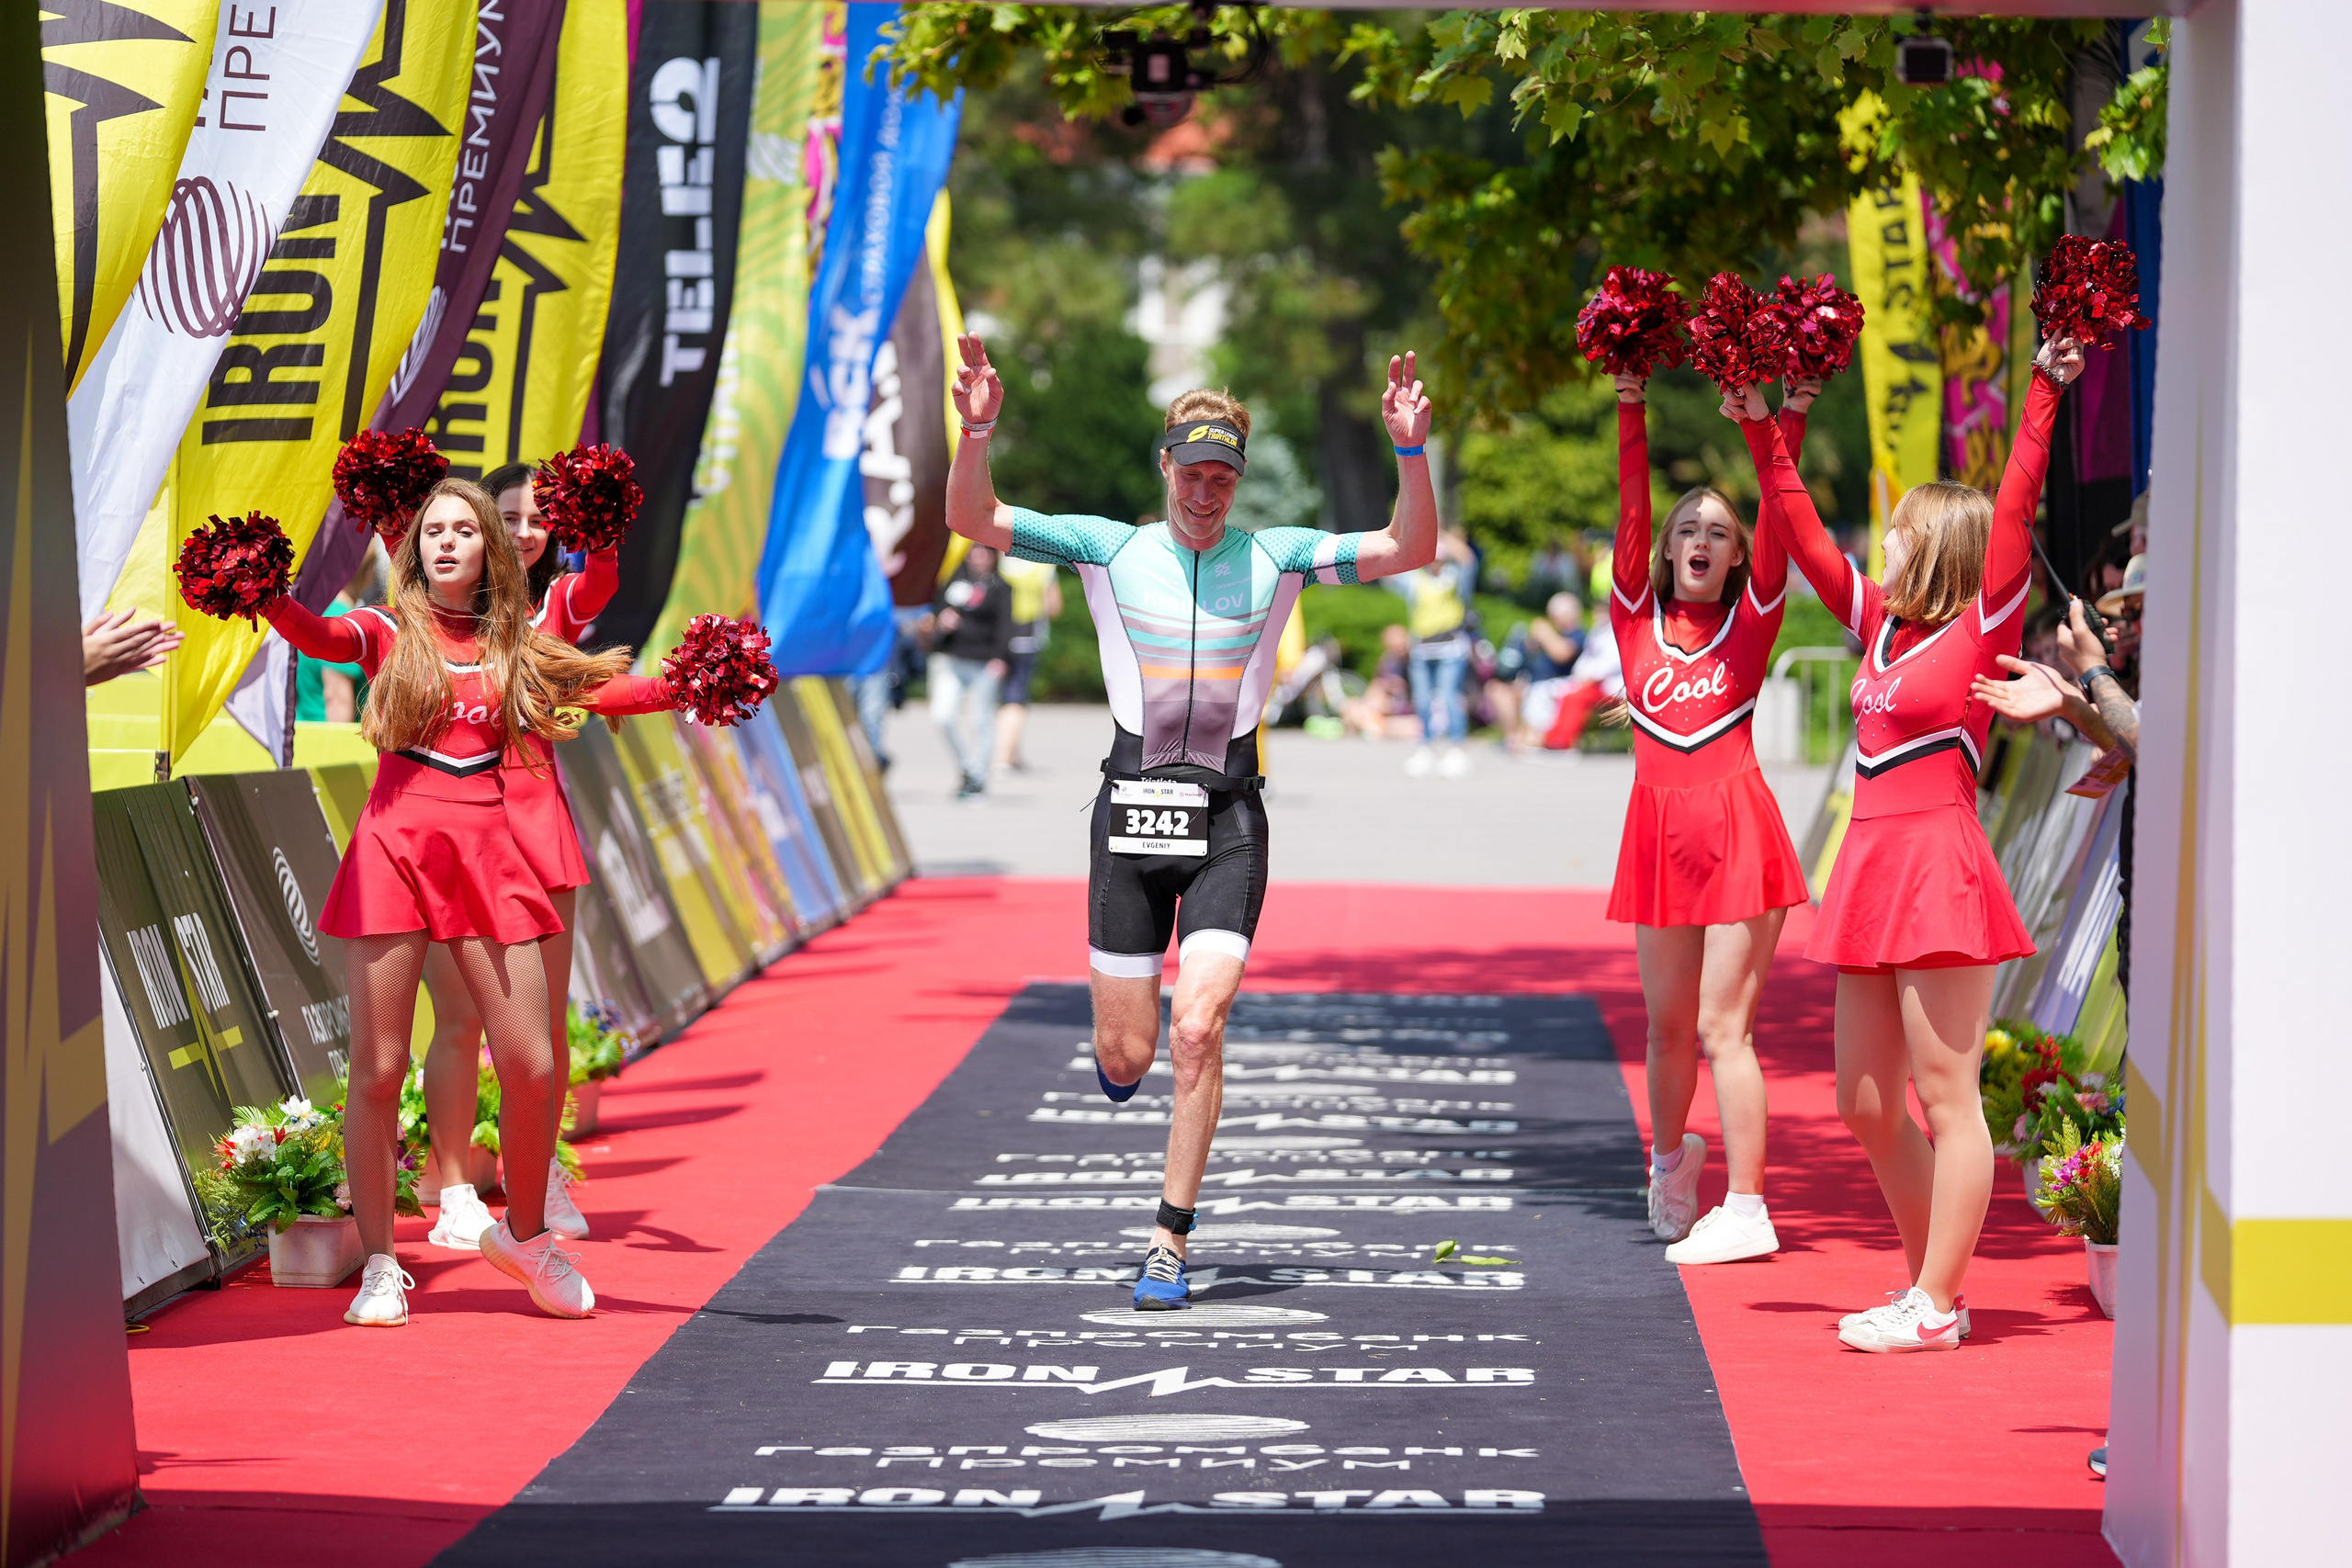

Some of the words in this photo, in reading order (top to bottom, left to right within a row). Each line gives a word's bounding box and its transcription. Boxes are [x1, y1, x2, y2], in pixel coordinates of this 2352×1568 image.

[1207, 433, 1238, 447] TRIATHLON
[1642, 660, 1728, 714] Cool
[1850, 676, 1903, 726] Cool
[1125, 808, 1190, 837] 3242
[126, 923, 190, 1031] IRON
[173, 911, 231, 1014] STAR
[1285, 1195, 1514, 1207] STAR
[897, 1266, 1146, 1280] IRON
[1269, 1268, 1525, 1286] STAR
[823, 1360, 1101, 1381] IRON
[1244, 1367, 1535, 1382] STAR
[722, 1486, 1043, 1507] IRON
[1208, 1489, 1546, 1509] STAR
